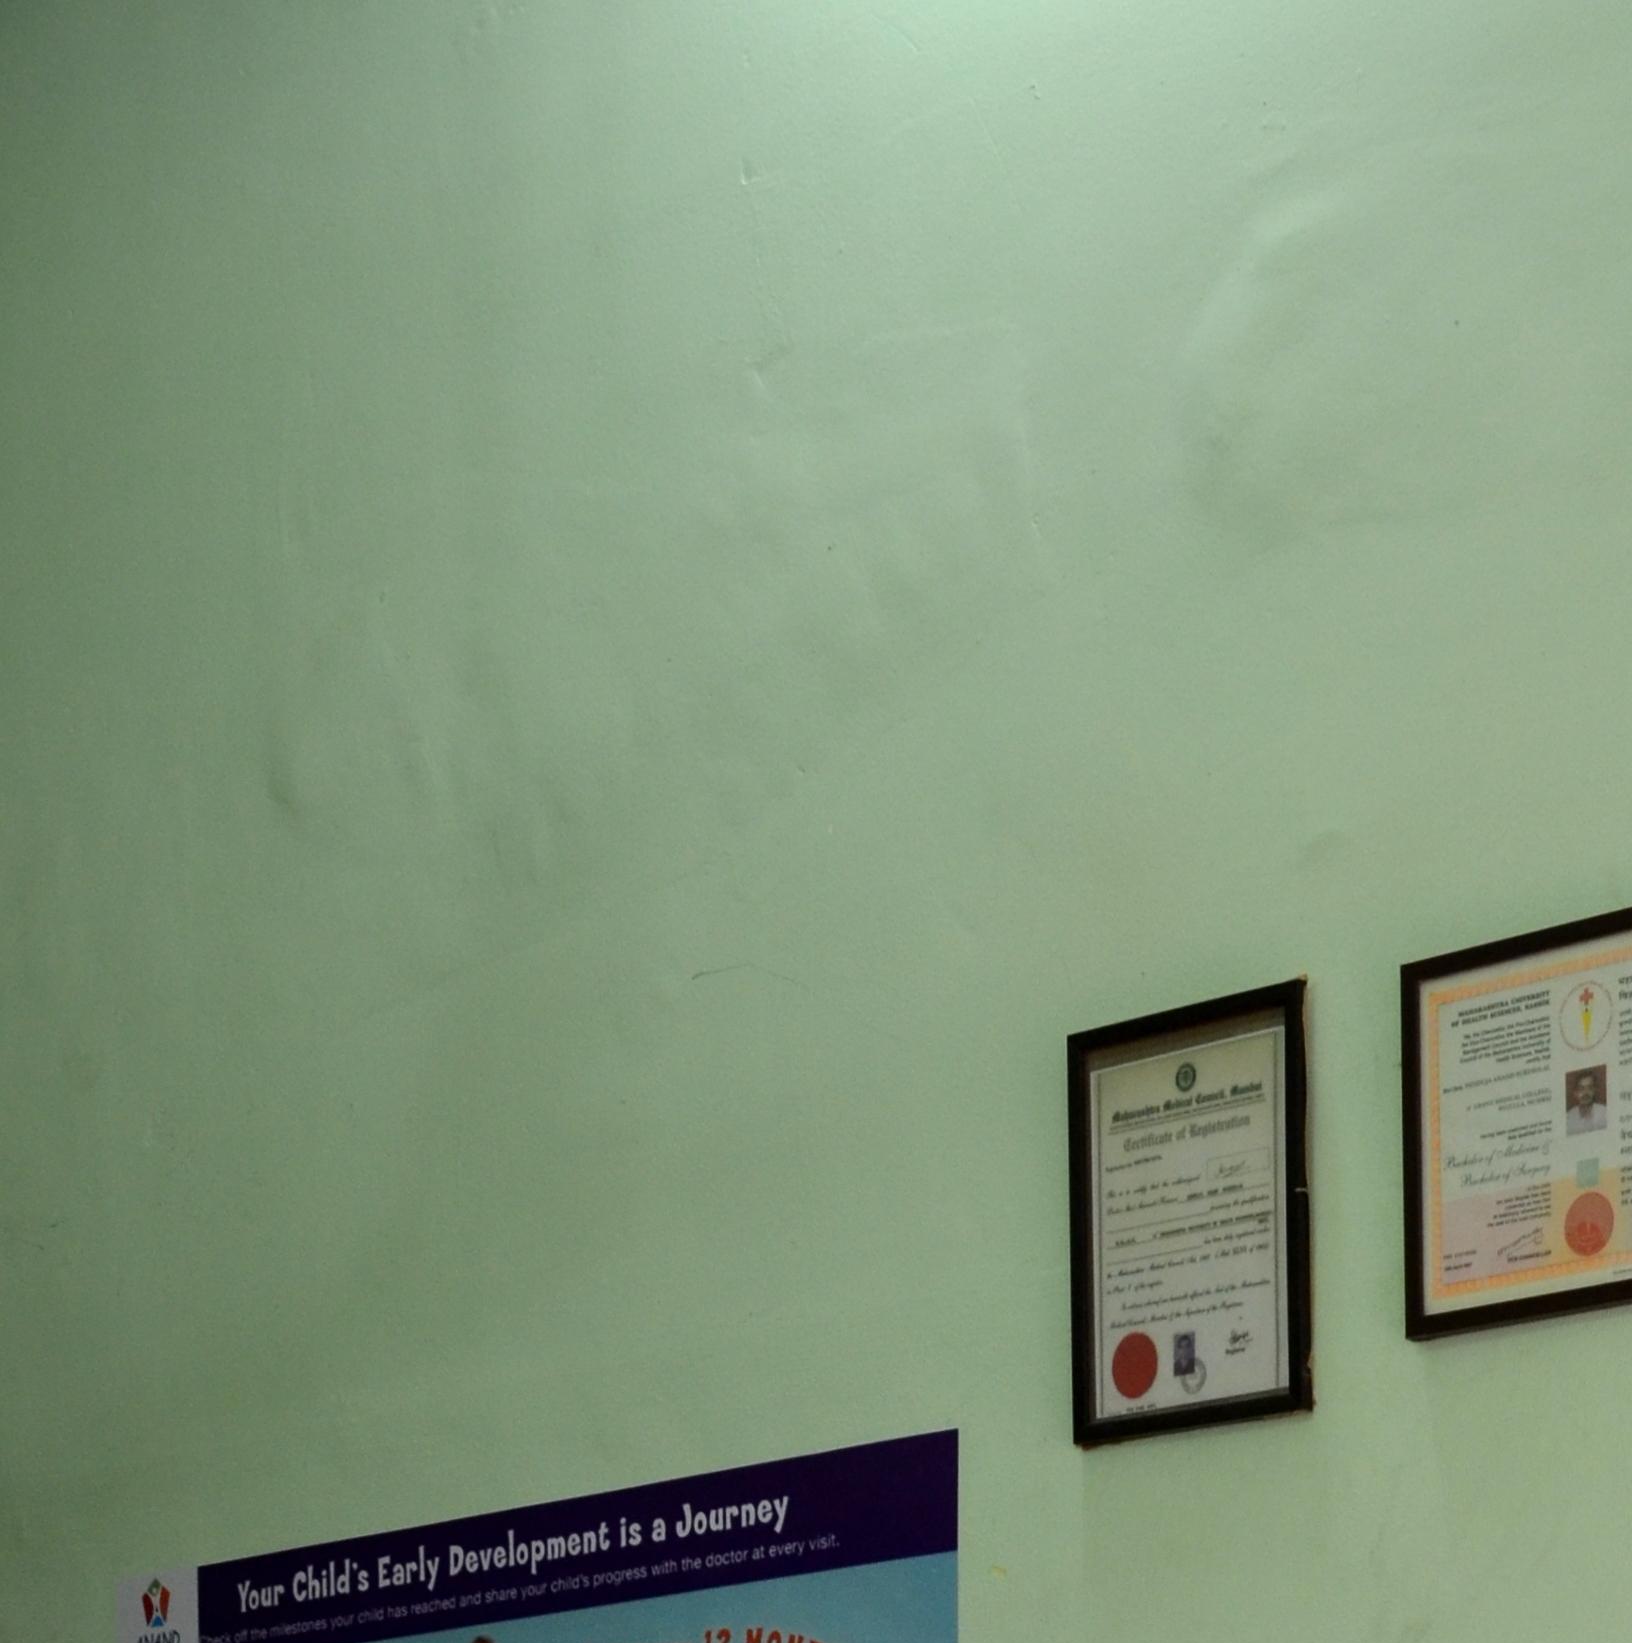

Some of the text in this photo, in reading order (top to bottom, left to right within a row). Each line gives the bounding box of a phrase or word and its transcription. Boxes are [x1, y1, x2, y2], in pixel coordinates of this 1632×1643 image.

[1123, 1115, 1251, 1152] Certificate of Registration
[238, 1495, 789, 1613] Your Child's Early Development is a Journey
[251, 1627, 267, 1642] the
[269, 1617, 328, 1640] milestones
[330, 1616, 355, 1635] your
[358, 1608, 384, 1627] child
[387, 1605, 409, 1621] has
[411, 1597, 458, 1616] reached
[460, 1592, 482, 1610] and
[485, 1587, 519, 1605] share
[521, 1582, 548, 1601] your
[550, 1573, 590, 1593] child's
[593, 1565, 648, 1588] progress
[651, 1558, 678, 1576] with
[682, 1555, 702, 1572] the
[706, 1548, 749, 1569] doctor
[752, 1546, 766, 1561] at
[769, 1541, 805, 1560] every
[810, 1533, 841, 1553] visit.
